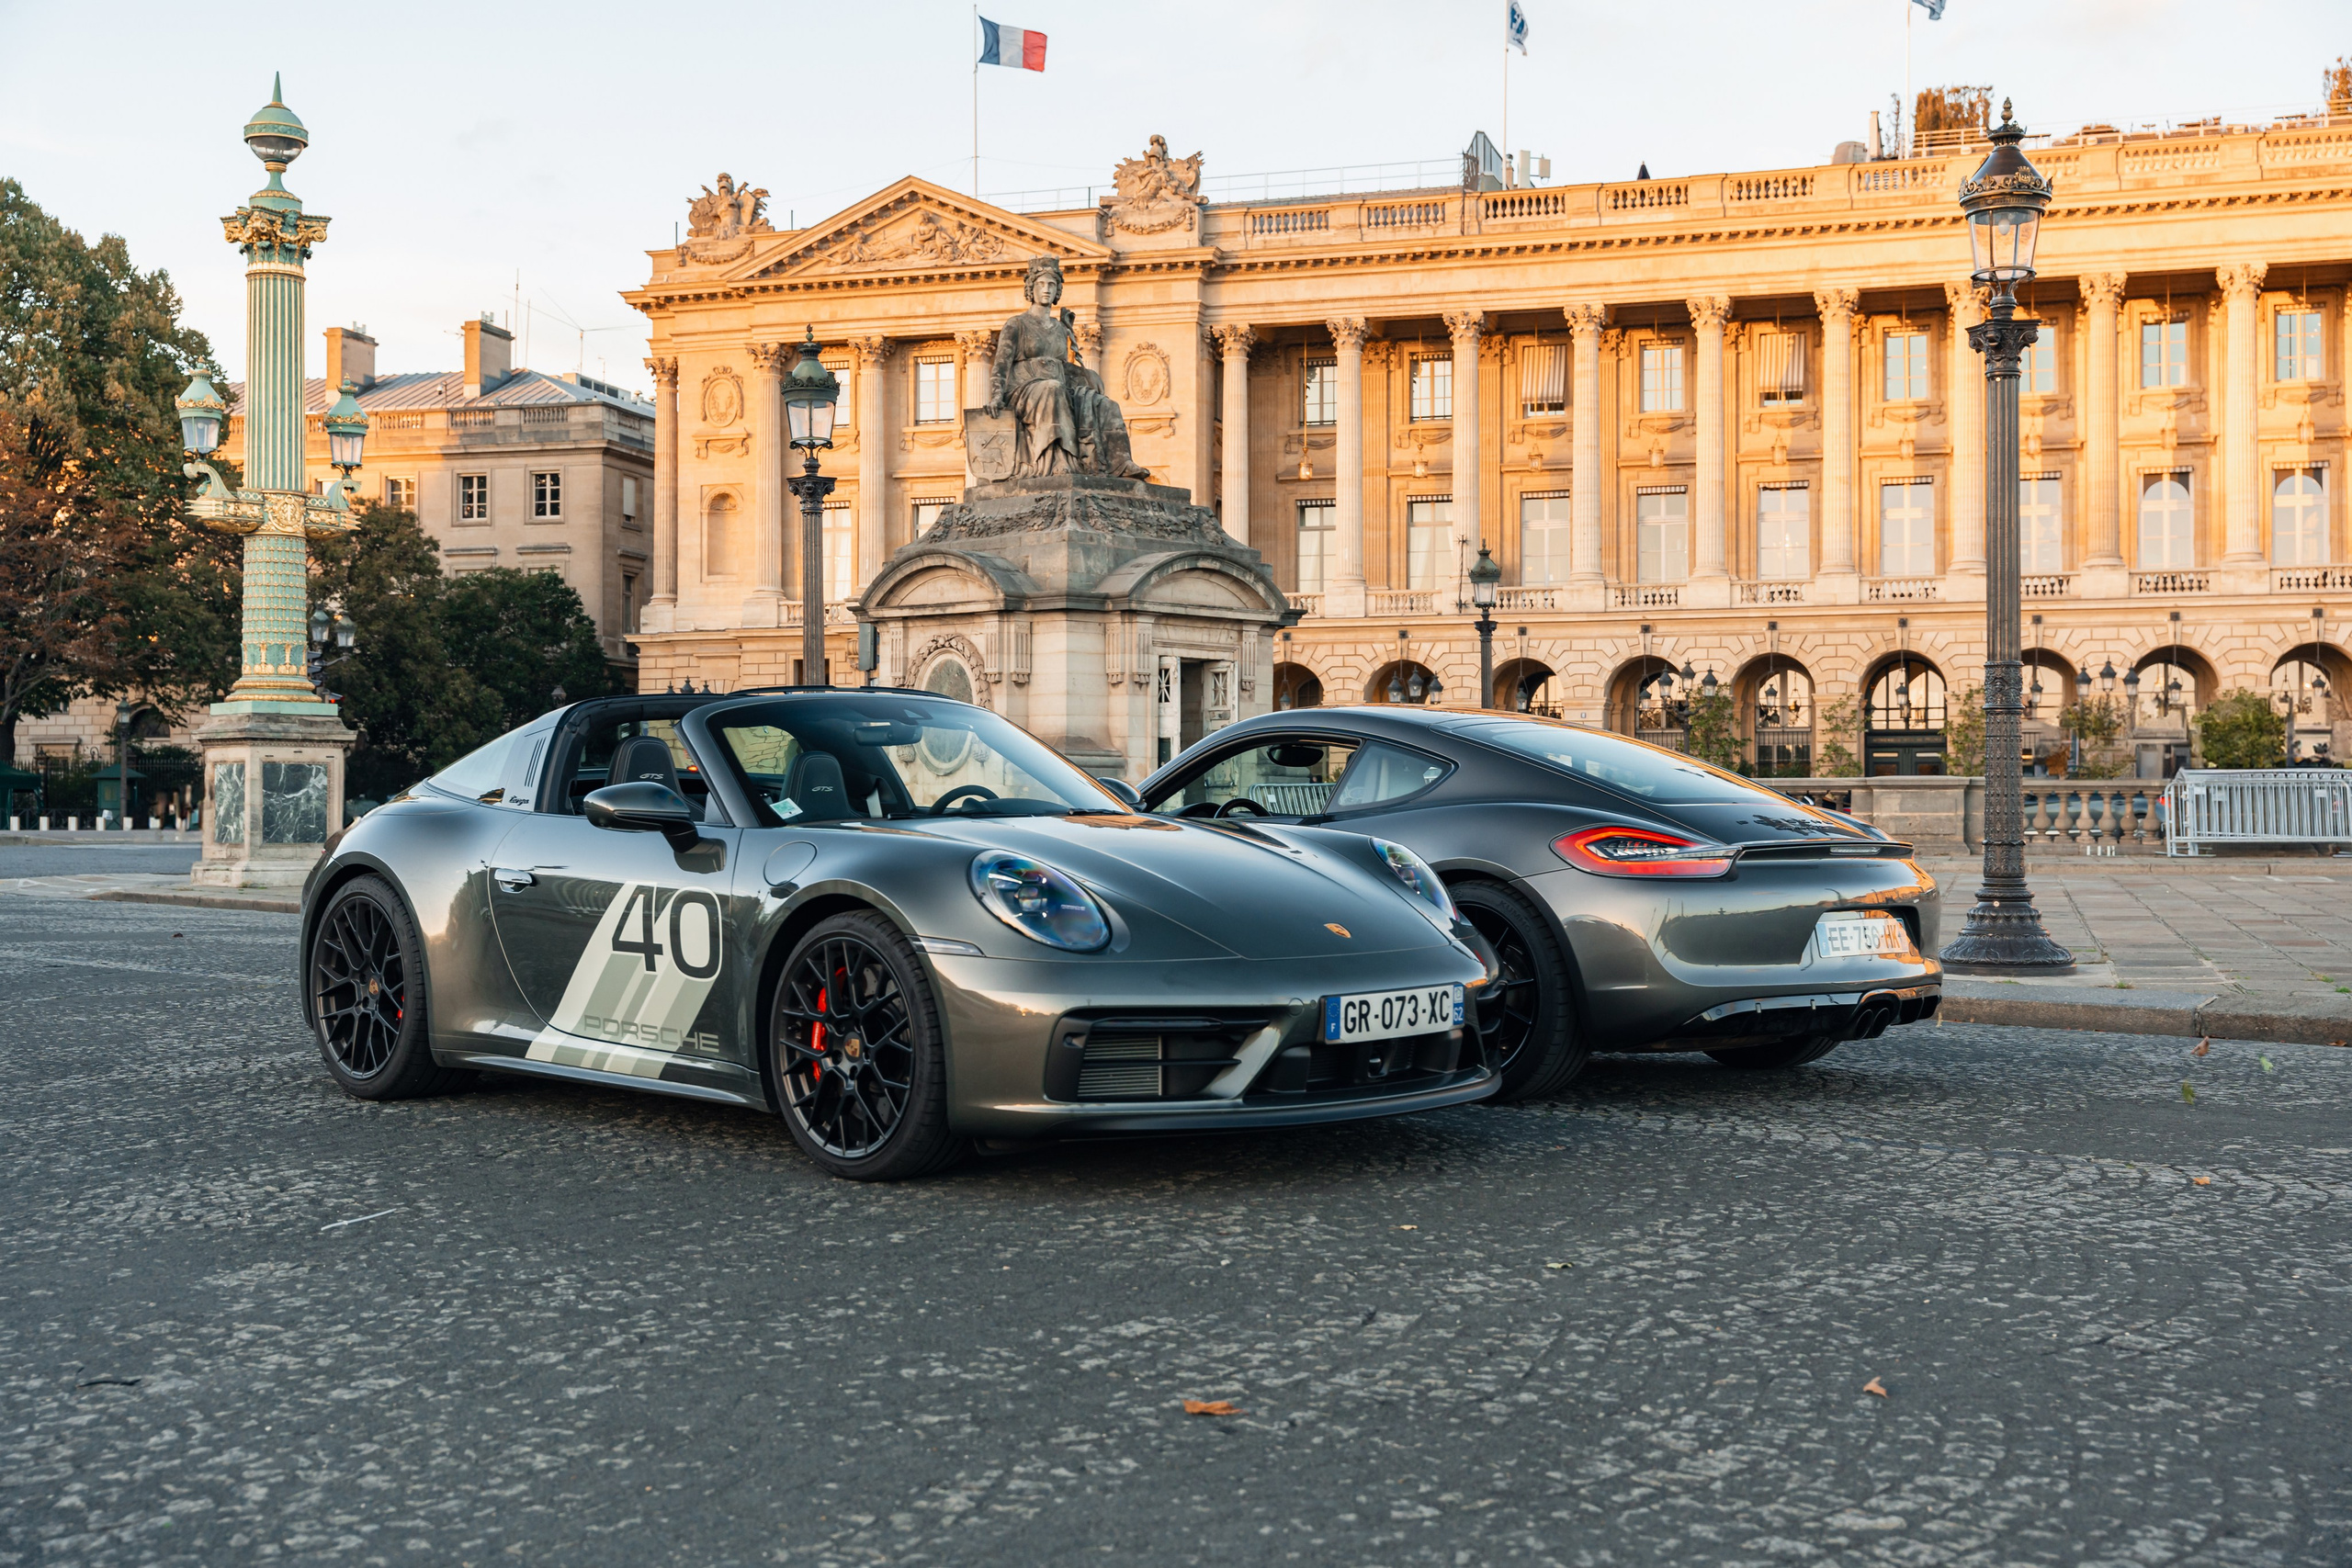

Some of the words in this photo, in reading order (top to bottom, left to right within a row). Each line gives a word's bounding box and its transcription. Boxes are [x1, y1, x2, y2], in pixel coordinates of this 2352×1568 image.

[611, 883, 721, 981] 40
[1497, 899, 1532, 933] KUMHO
[1330, 1022, 1336, 1033] F
[1344, 990, 1450, 1034] GR-073-XC
[1453, 1006, 1464, 1021] 62
[584, 1014, 719, 1054] PORSCHE
